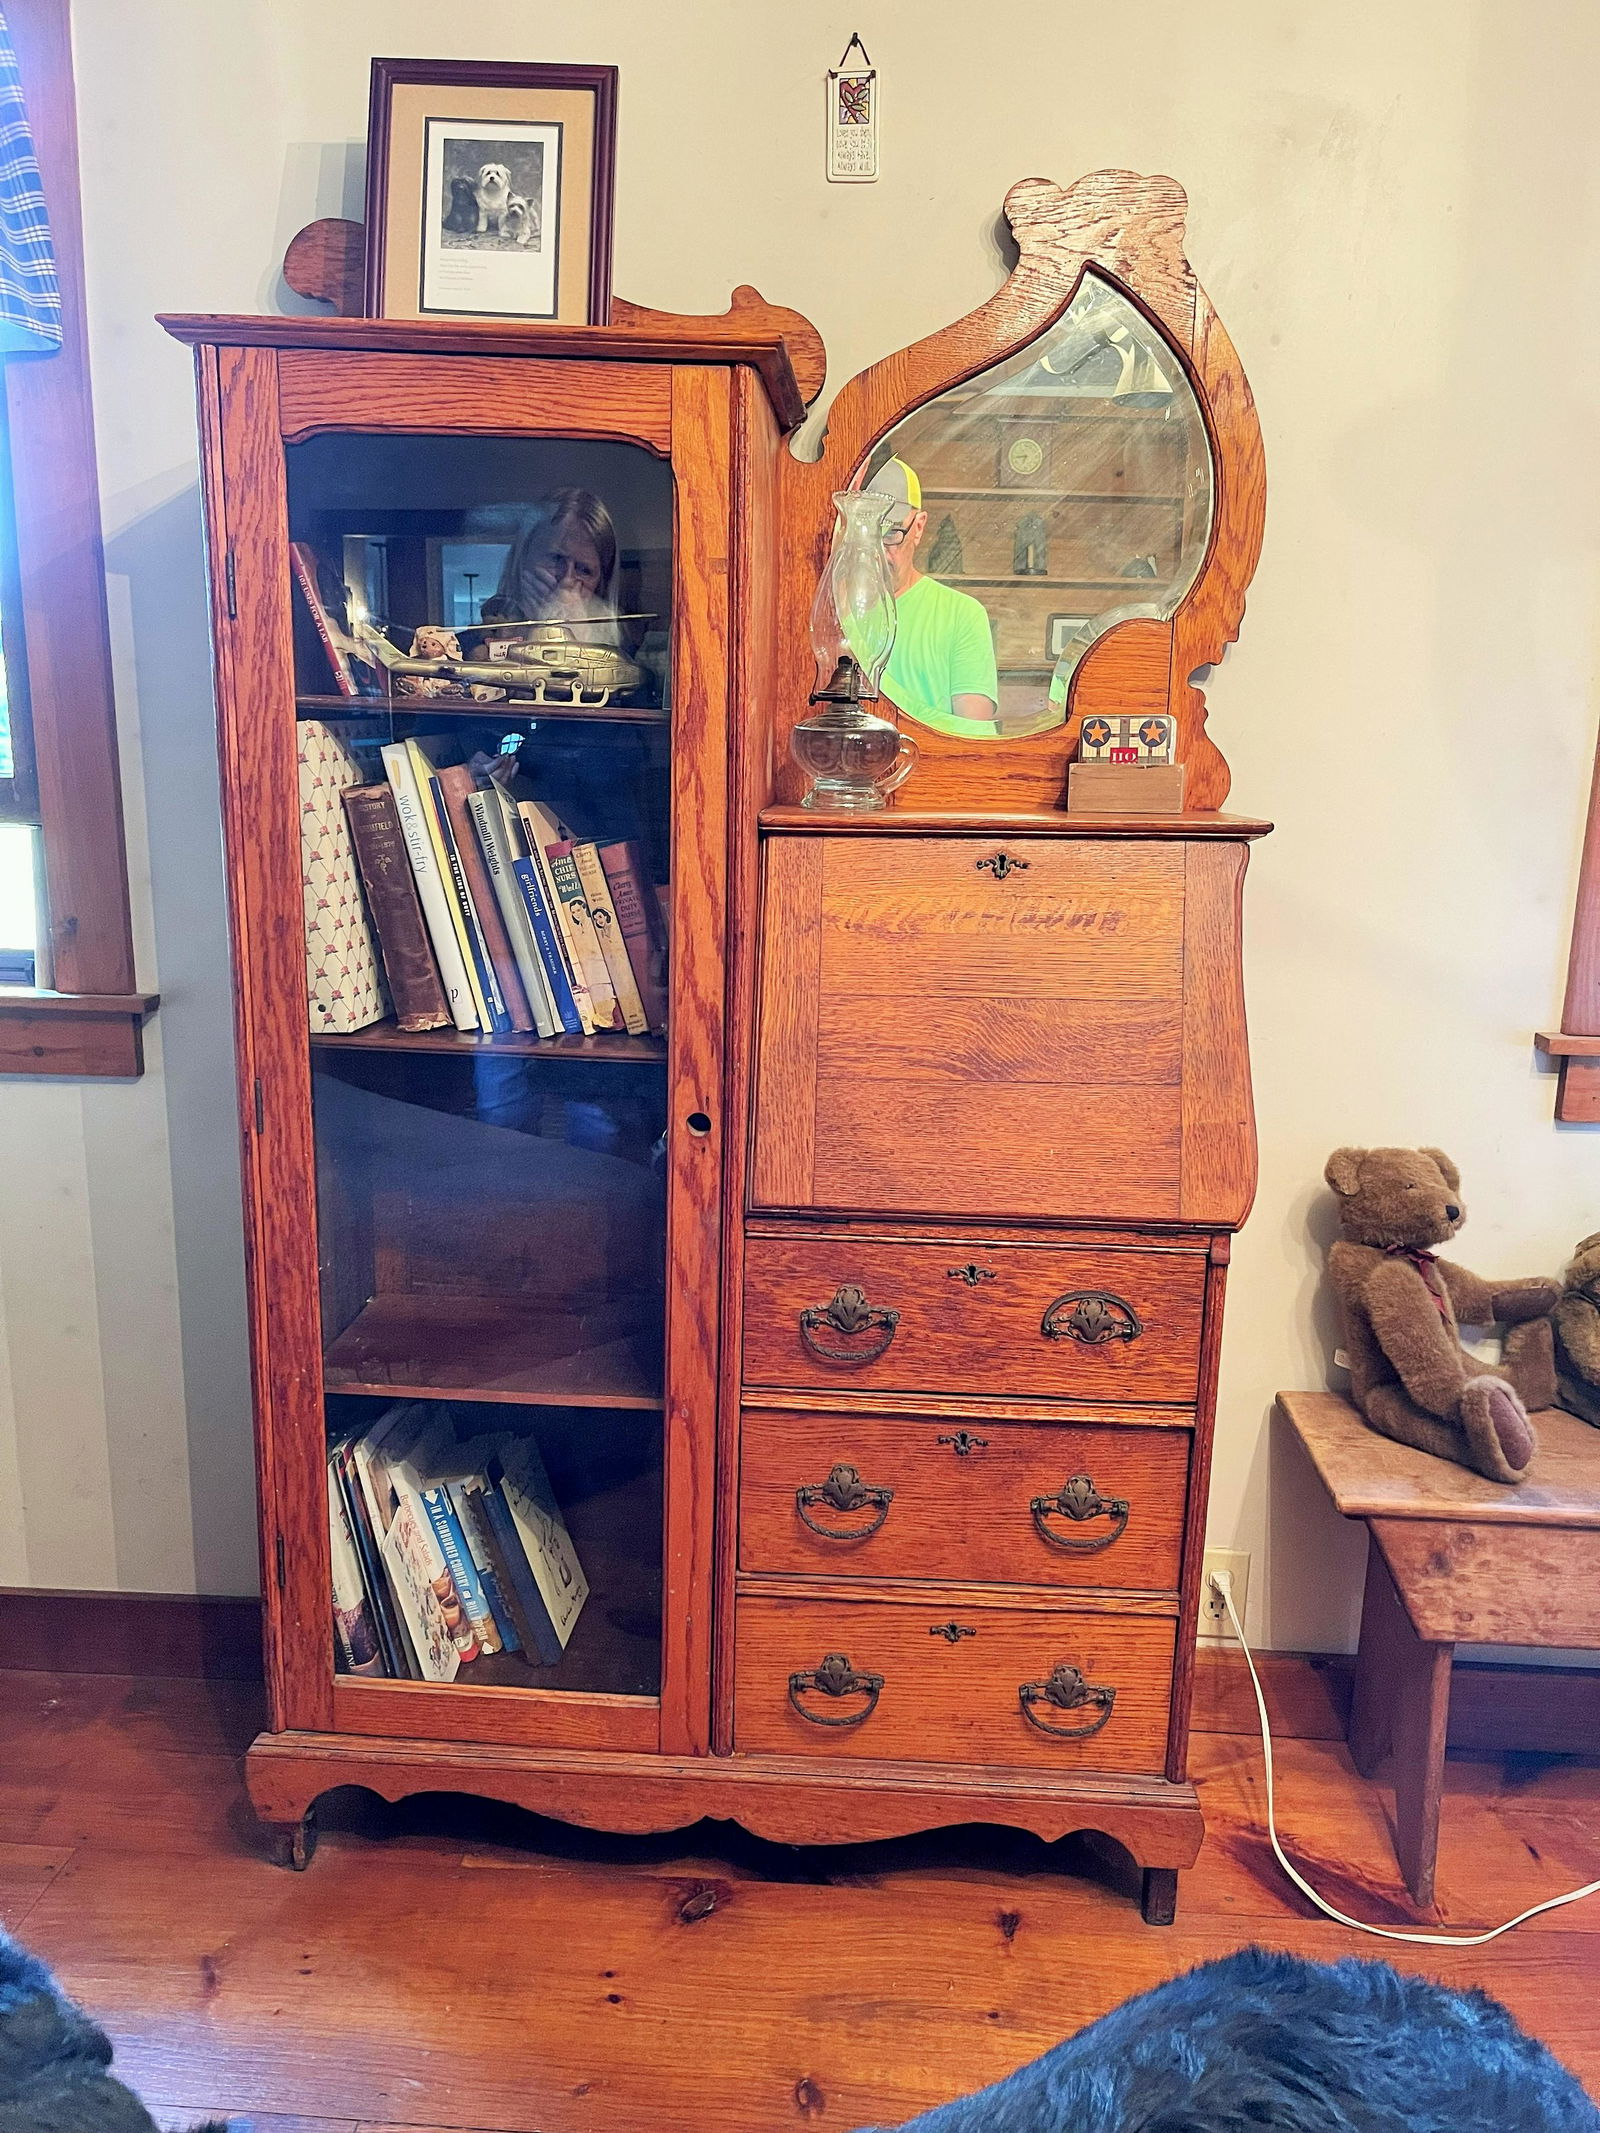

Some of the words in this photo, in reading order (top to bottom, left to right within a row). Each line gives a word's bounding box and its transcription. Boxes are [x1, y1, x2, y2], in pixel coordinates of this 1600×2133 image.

[309, 605, 320, 620] FOR
[474, 802, 493, 845] Windmill
[486, 840, 500, 876] Weights
[459, 891, 467, 899] OF
[520, 873, 541, 917] girlfriends
[620, 902, 638, 912] DUTY
[429, 1504, 439, 1514] IN
[433, 1514, 443, 1522] A
[435, 1520, 459, 1559] SUNBURNED
[451, 1557, 471, 1588] COUNTRY
